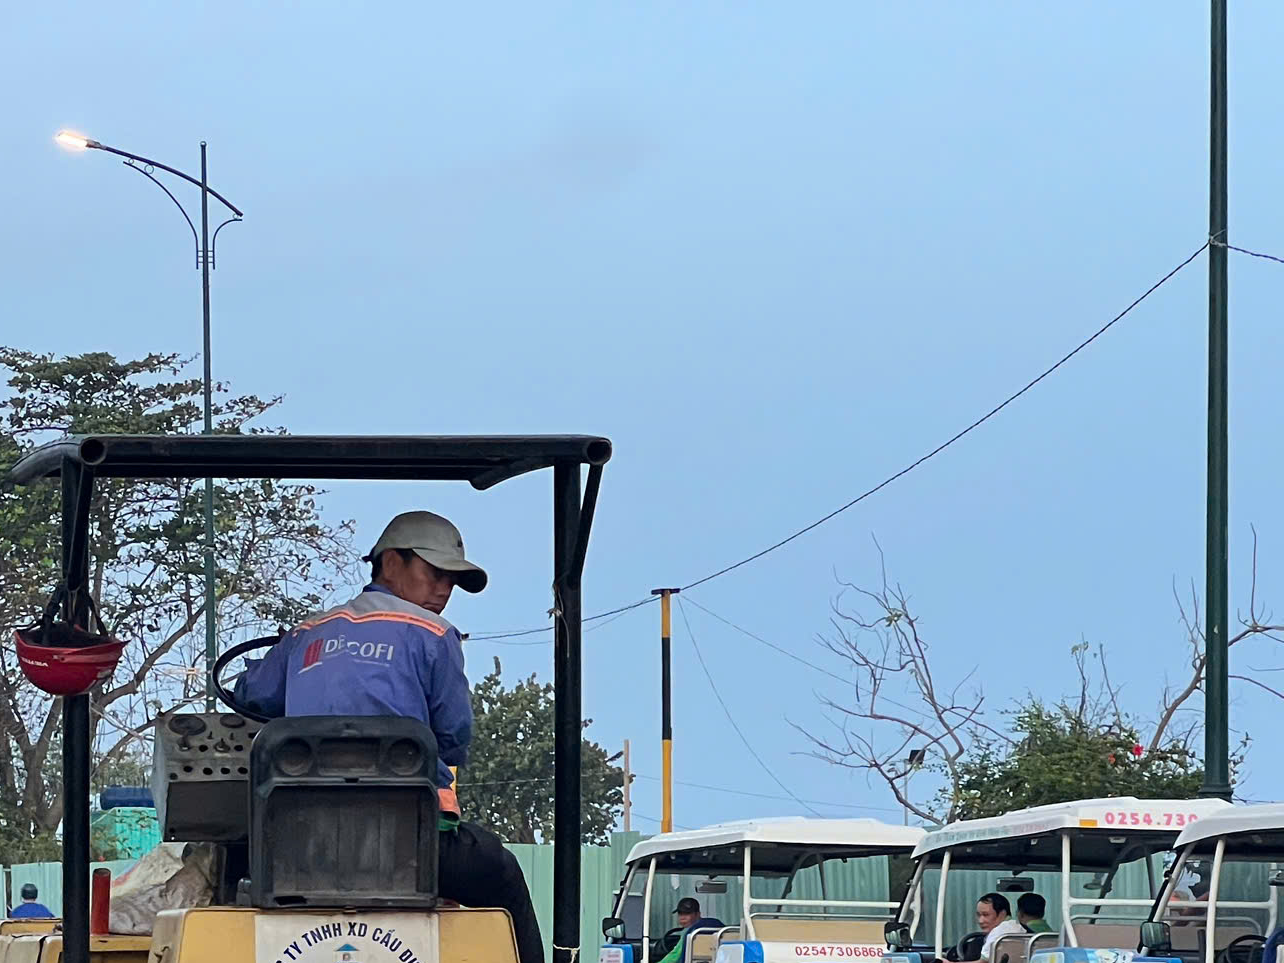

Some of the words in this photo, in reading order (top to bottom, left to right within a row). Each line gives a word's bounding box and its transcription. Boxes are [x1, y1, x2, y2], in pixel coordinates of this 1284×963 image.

[283, 941, 303, 961] TY
[301, 922, 343, 947] TNHH
[347, 921, 368, 937] XD
[795, 946, 884, 957] 02547306868
